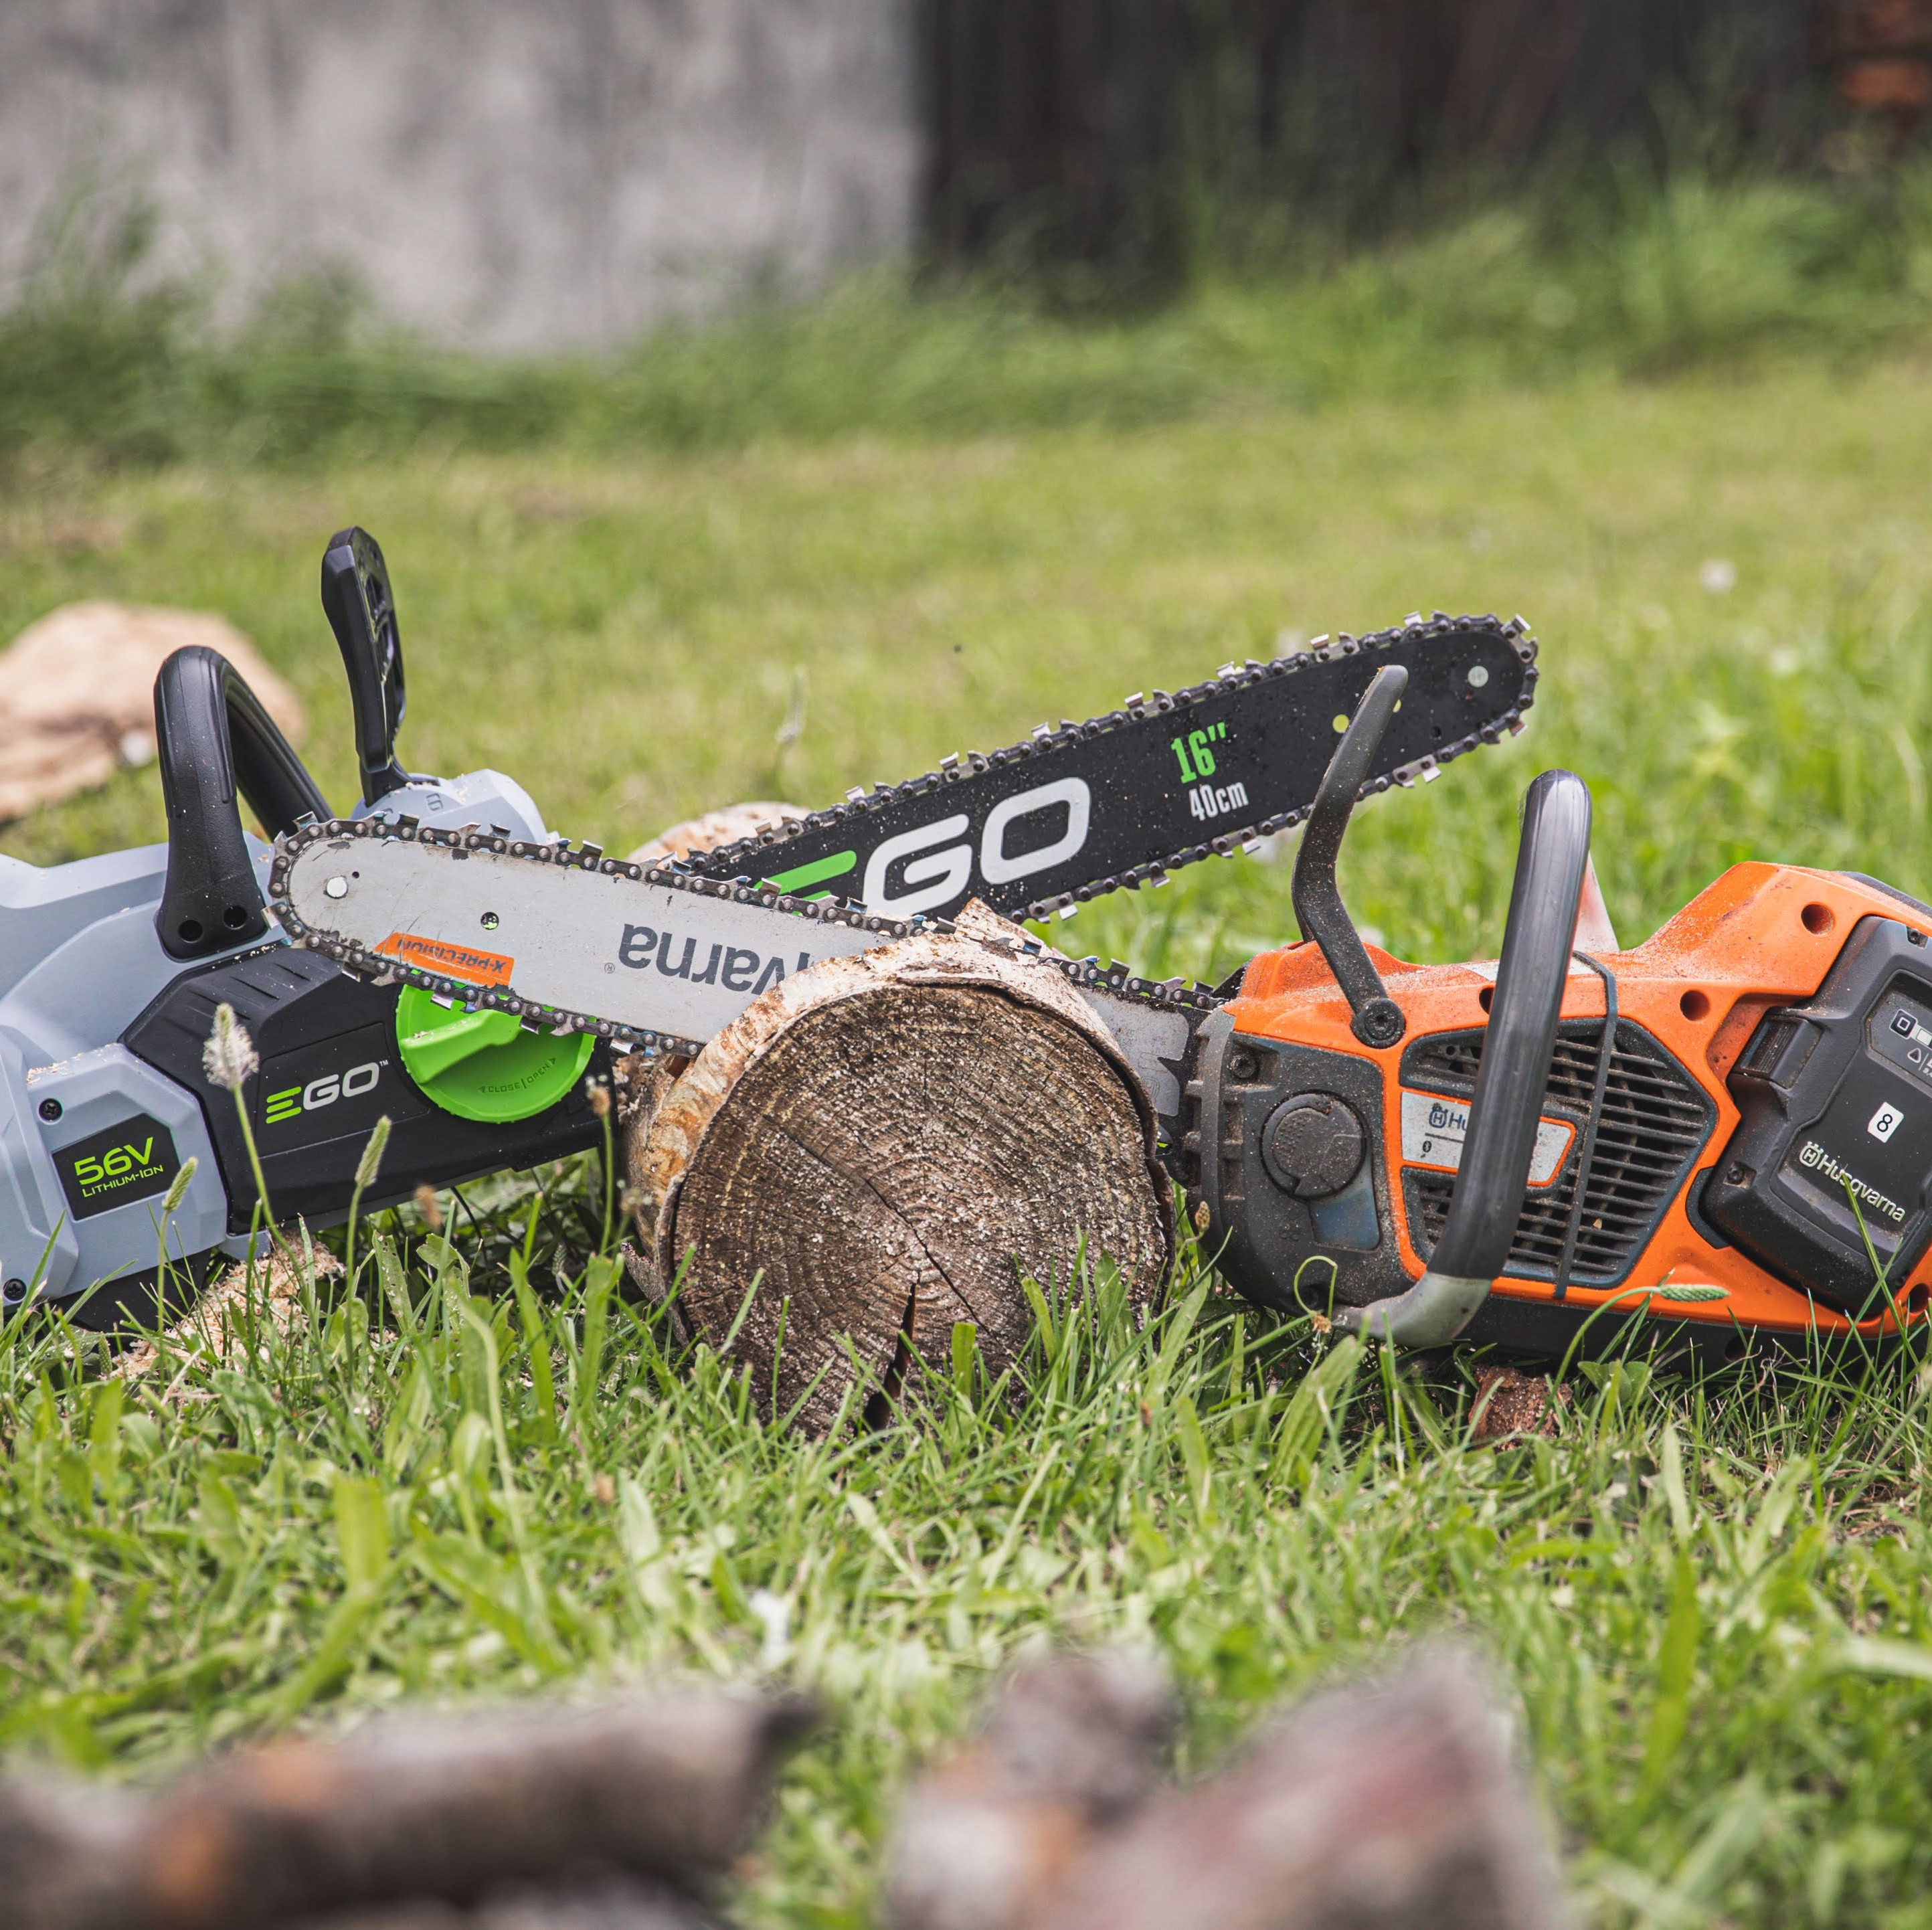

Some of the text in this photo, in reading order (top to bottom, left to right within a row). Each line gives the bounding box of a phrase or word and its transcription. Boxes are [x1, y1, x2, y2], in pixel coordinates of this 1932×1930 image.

[1189, 782, 1249, 821] 40cm
[396, 939, 507, 973] X-PRECISION
[618, 924, 811, 996] varna
[266, 1062, 379, 1124] EGO
[488, 1063, 550, 1093] CLOSE OPEN
[1876, 1114, 1893, 1132] 8
[74, 1137, 153, 1185] 56V
[1816, 1154, 1906, 1223] Husqvarna
